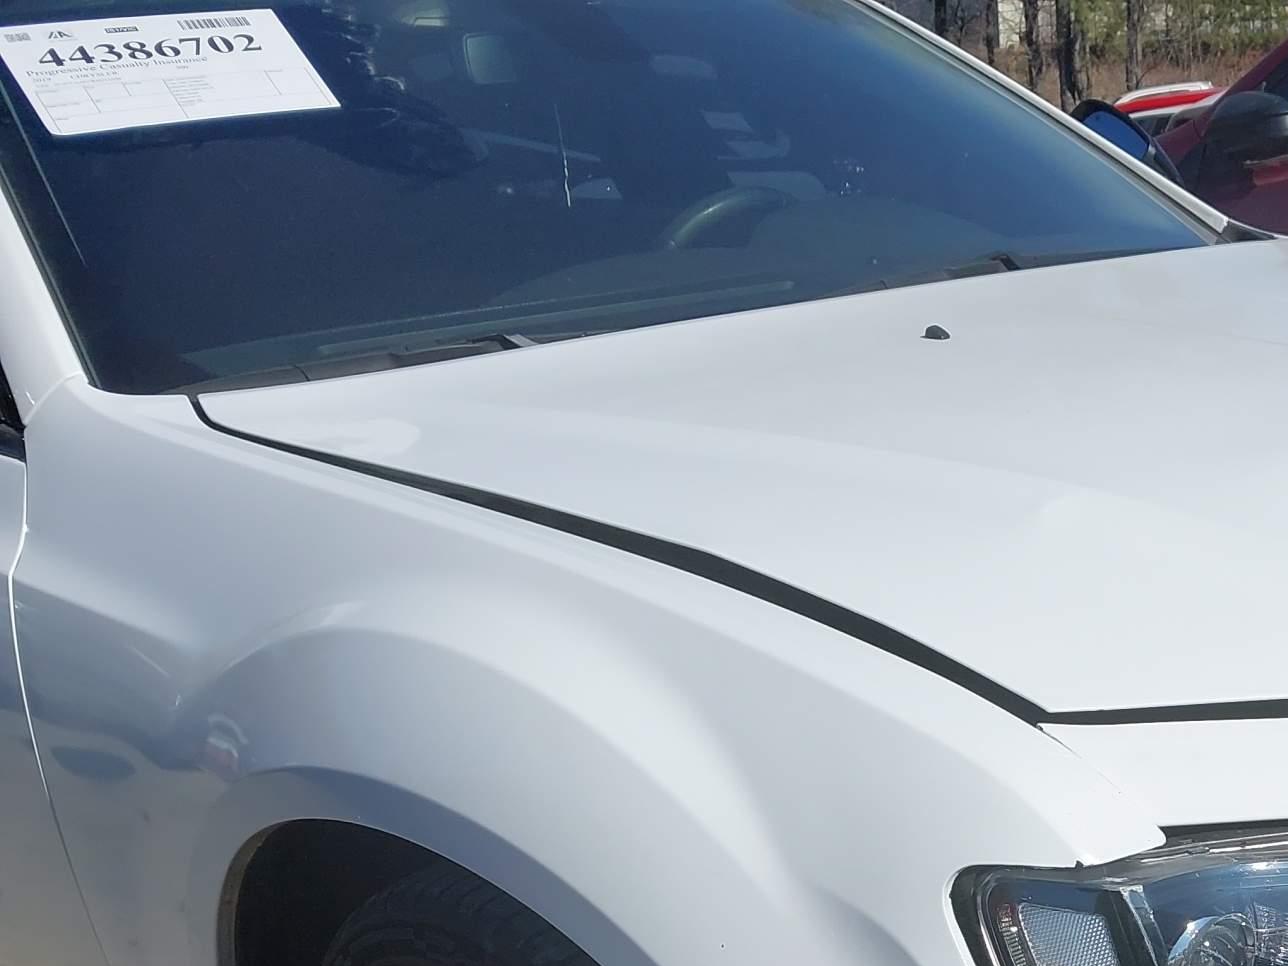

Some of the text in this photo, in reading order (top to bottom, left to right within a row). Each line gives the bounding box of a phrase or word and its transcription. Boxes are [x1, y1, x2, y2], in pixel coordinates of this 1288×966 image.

[38, 34, 262, 67] 44386702
[25, 57, 208, 77] Progressive Casualty Insurance
